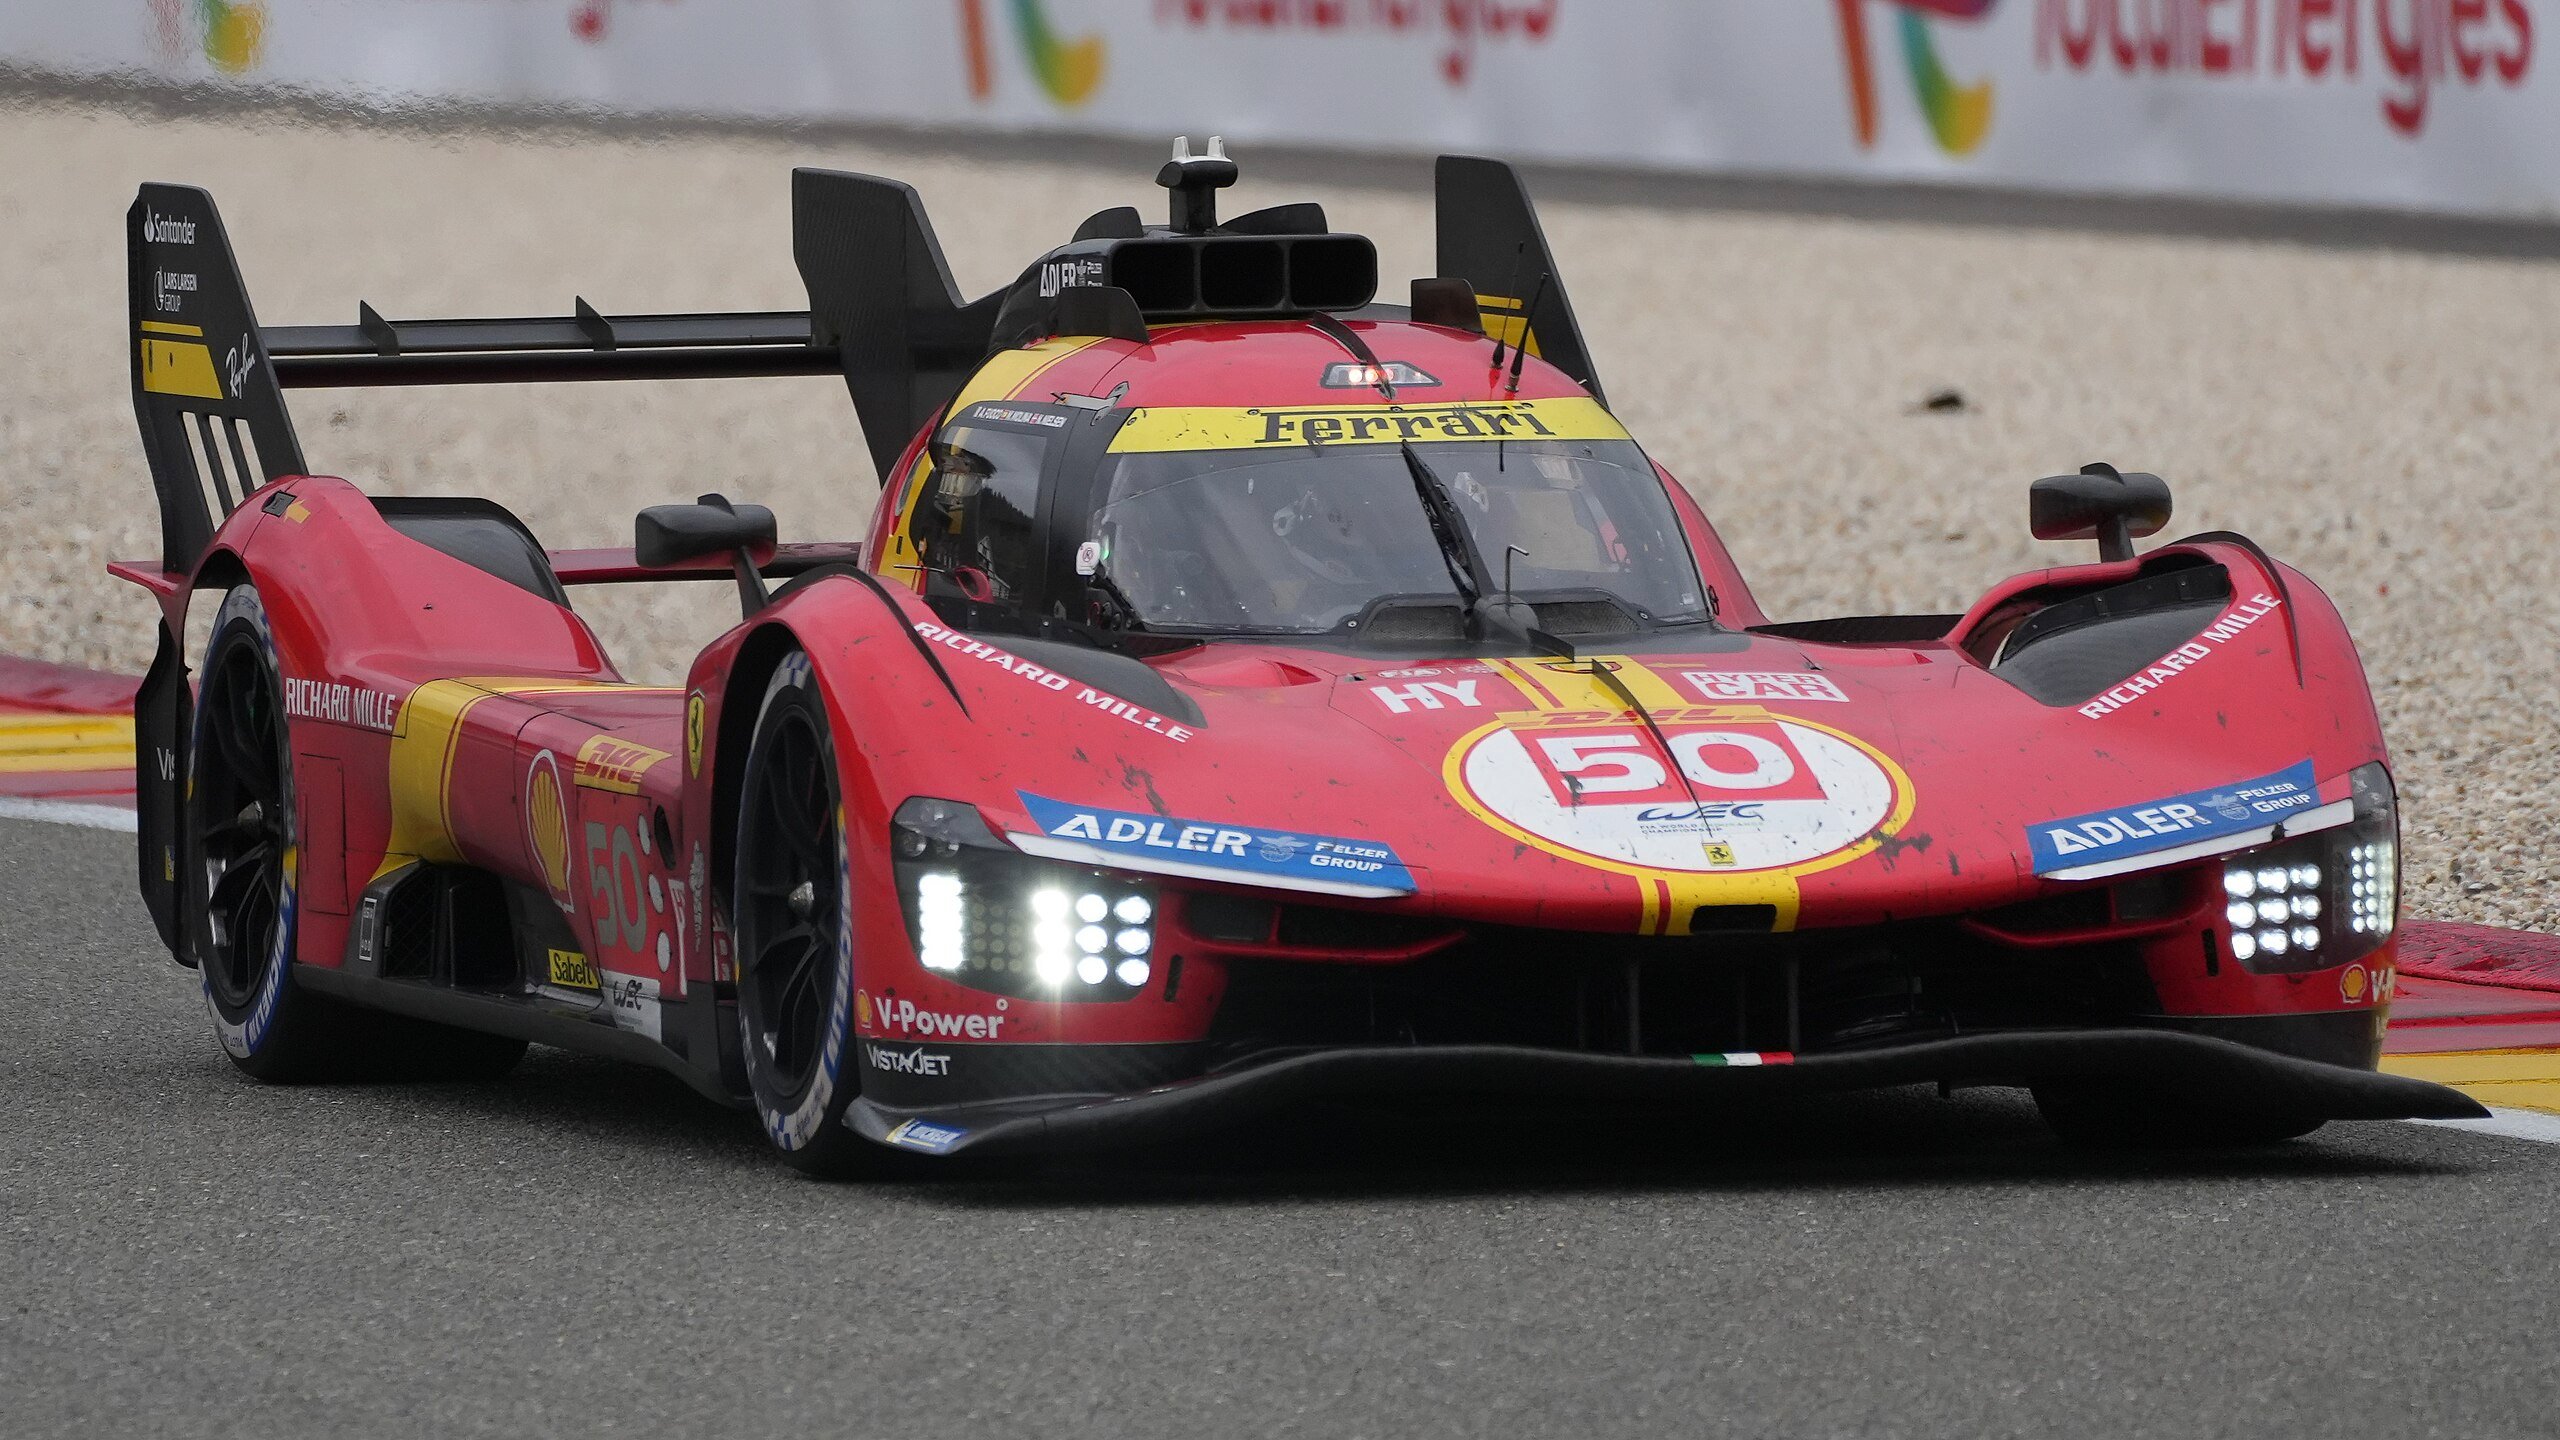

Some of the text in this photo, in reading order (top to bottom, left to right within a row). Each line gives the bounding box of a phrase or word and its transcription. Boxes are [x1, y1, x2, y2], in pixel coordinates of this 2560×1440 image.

[154, 213, 196, 244] Santander
[164, 272, 178, 290] LARS
[1254, 405, 1556, 444] Ferrari
[2078, 593, 2282, 720] RICHARD MILLE
[913, 621, 1194, 743] RICHARD MILLE
[1369, 680, 1482, 714] HY
[1705, 682, 1837, 698] CAR
[285, 677, 396, 731] RICHARD MILLE
[1535, 732, 1796, 795] 50
[2234, 782, 2298, 802] PELZER
[2251, 793, 2311, 814] GROUP
[1050, 814, 1253, 857] ADLER
[2044, 803, 2212, 856] ADLER
[1310, 854, 1385, 874] GROUP
[585, 821, 647, 954] 50
[553, 952, 593, 985] Sabelt
[875, 997, 1004, 1039] V-Power
